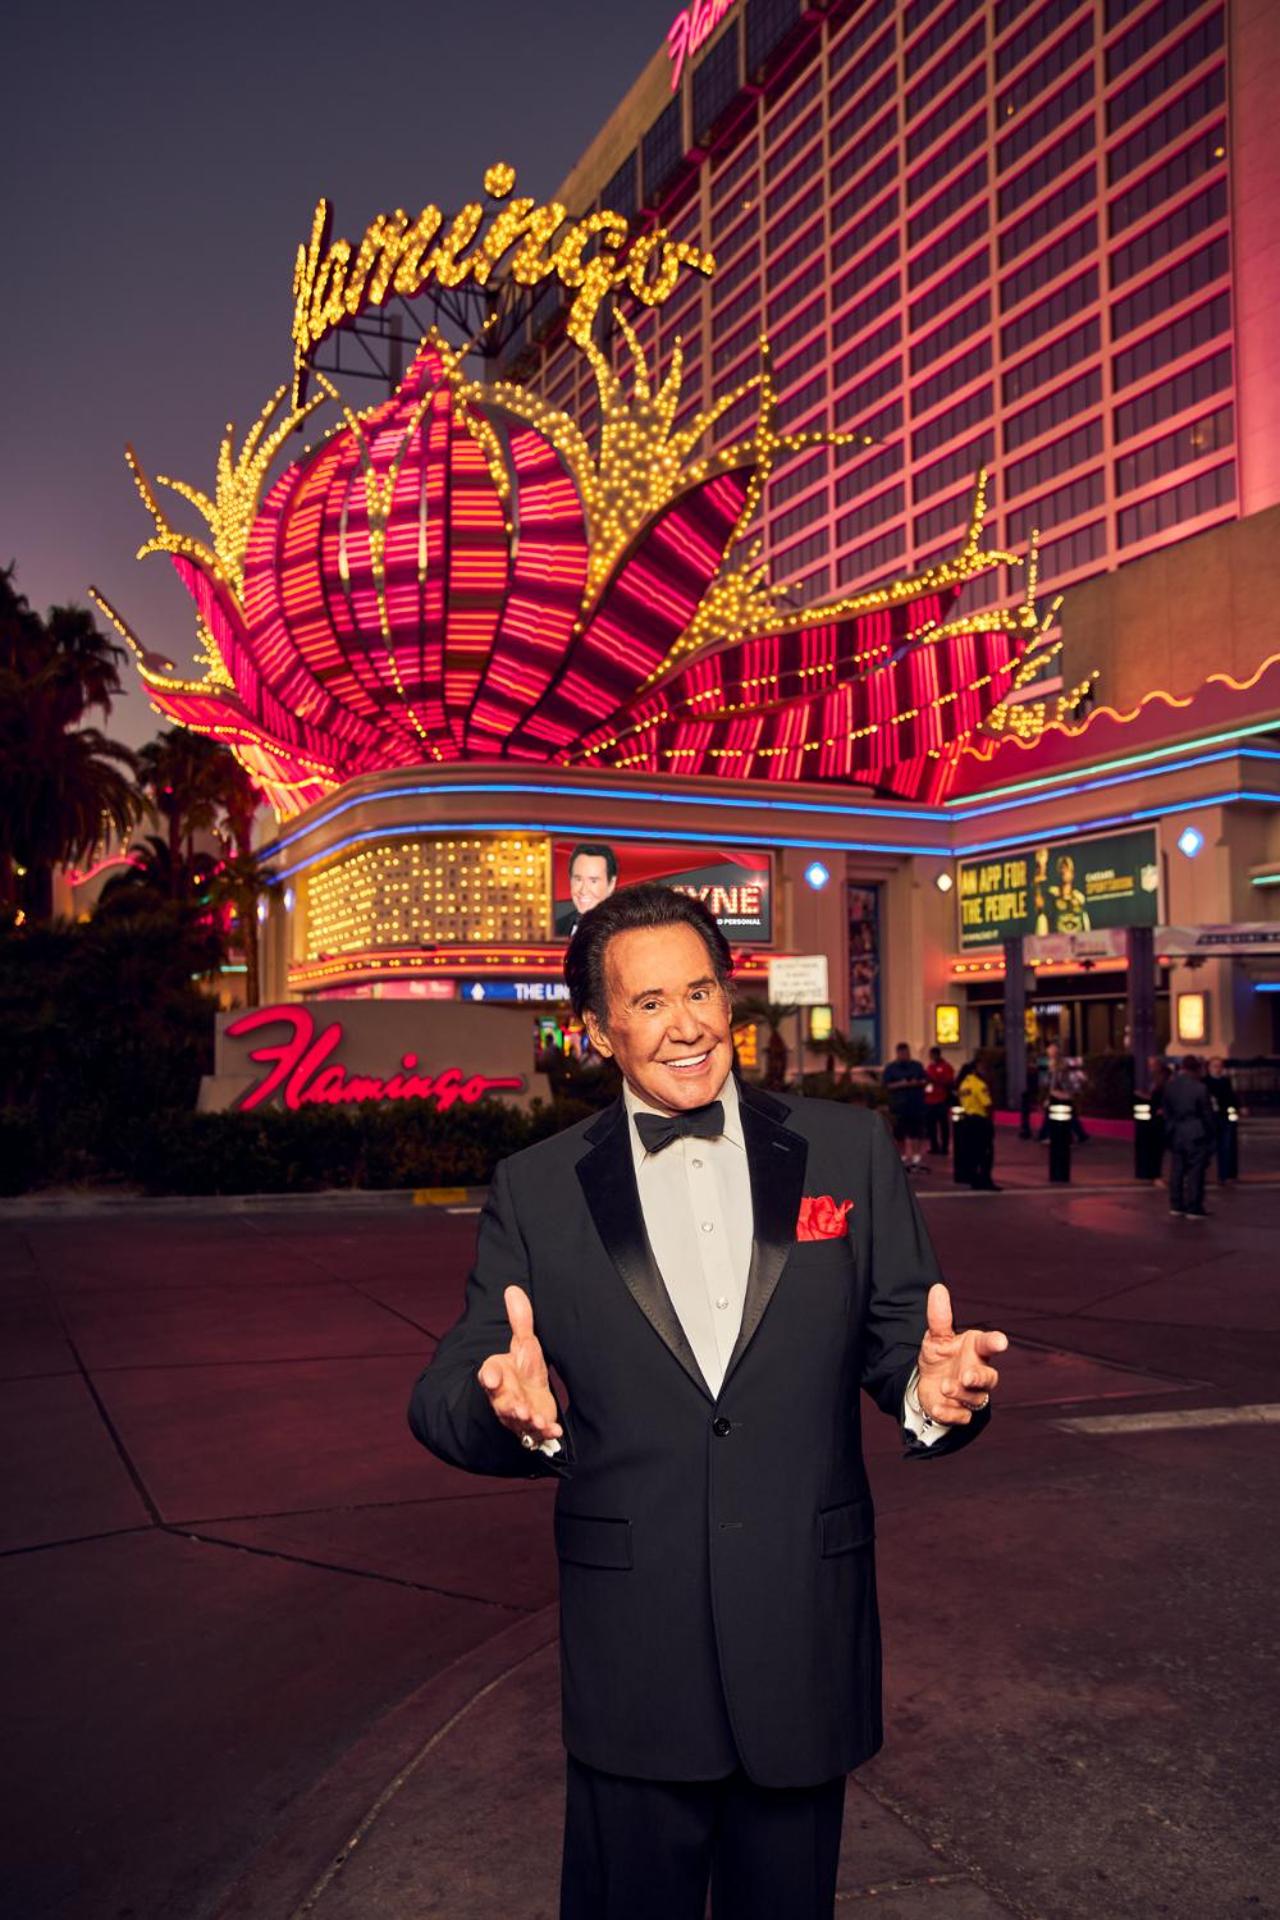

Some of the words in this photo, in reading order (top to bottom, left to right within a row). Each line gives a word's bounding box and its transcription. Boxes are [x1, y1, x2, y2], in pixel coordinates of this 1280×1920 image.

[980, 864, 1001, 893] APP
[1004, 860, 1027, 889] FOR
[724, 918, 762, 926] PERSONAL
[961, 898, 982, 925] THE
[984, 890, 1028, 922] PEOPLE
[514, 983, 544, 1000] THE
[225, 1003, 523, 1112] Flamingo
